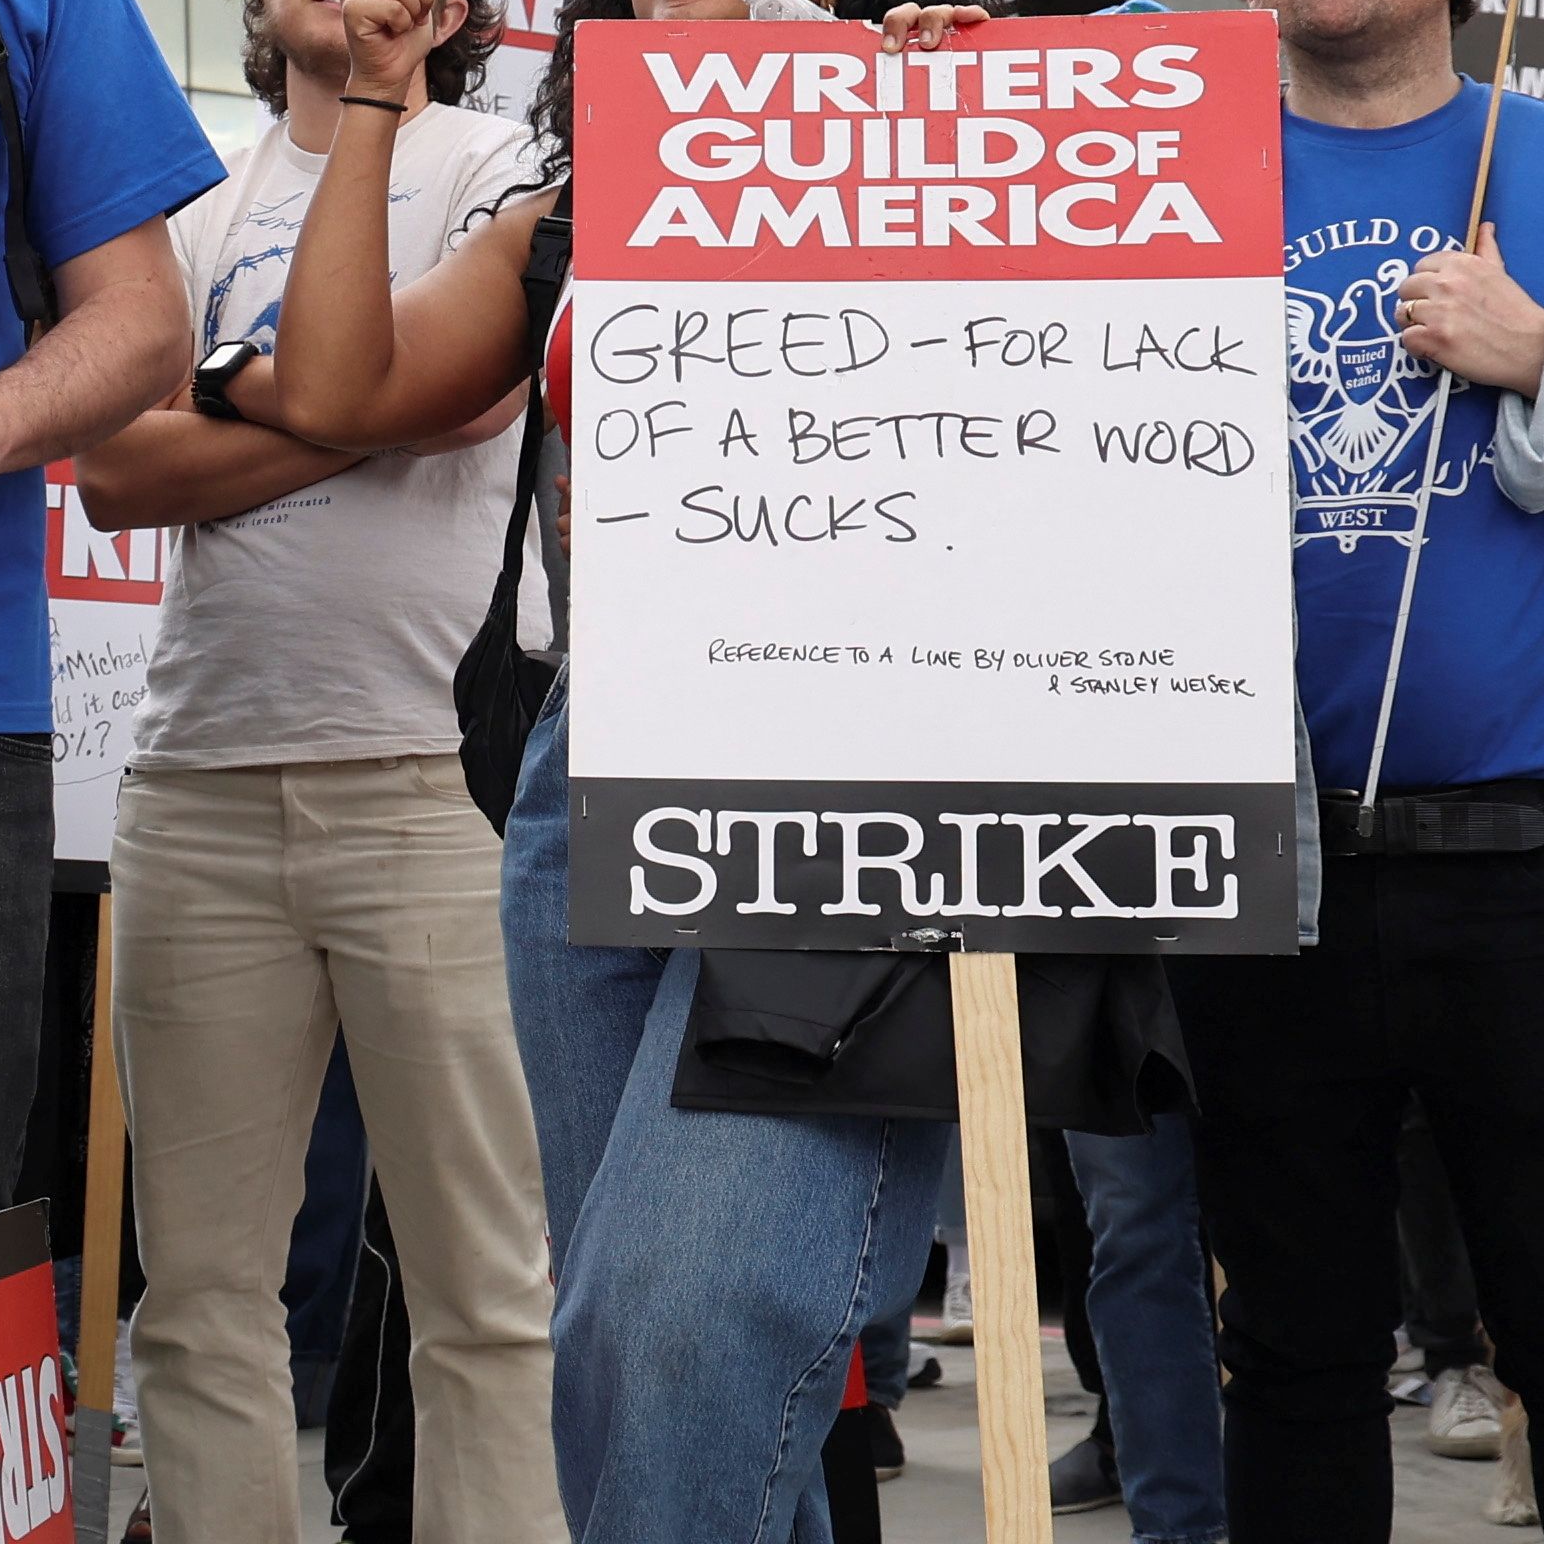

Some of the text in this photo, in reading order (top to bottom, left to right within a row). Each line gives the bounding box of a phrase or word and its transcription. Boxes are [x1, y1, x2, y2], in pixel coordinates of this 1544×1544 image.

[641, 44, 1206, 114] WRITERS
[659, 116, 1181, 180] GUILD OF
[625, 182, 1224, 249] AMERICA
[591, 304, 890, 384] GREED
[964, 317, 1073, 370] FOR
[1101, 322, 1258, 377] LACK
[1341, 347, 1387, 366] united
[1344, 370, 1382, 390] stand
[1355, 361, 1374, 377] we
[594, 401, 1255, 478] OF A BETTER WORD
[674, 484, 955, 553] SUCKS.
[1317, 506, 1388, 530] WEST
[65, 633, 148, 681] Michael
[707, 637, 1176, 671] REFERENCE TO A LINE BY OLIVER STONE
[83, 693, 104, 717] it
[1070, 676, 1160, 697] STANLEY
[1170, 675, 1256, 699] WEISER
[628, 805, 1239, 920] STRIKE
